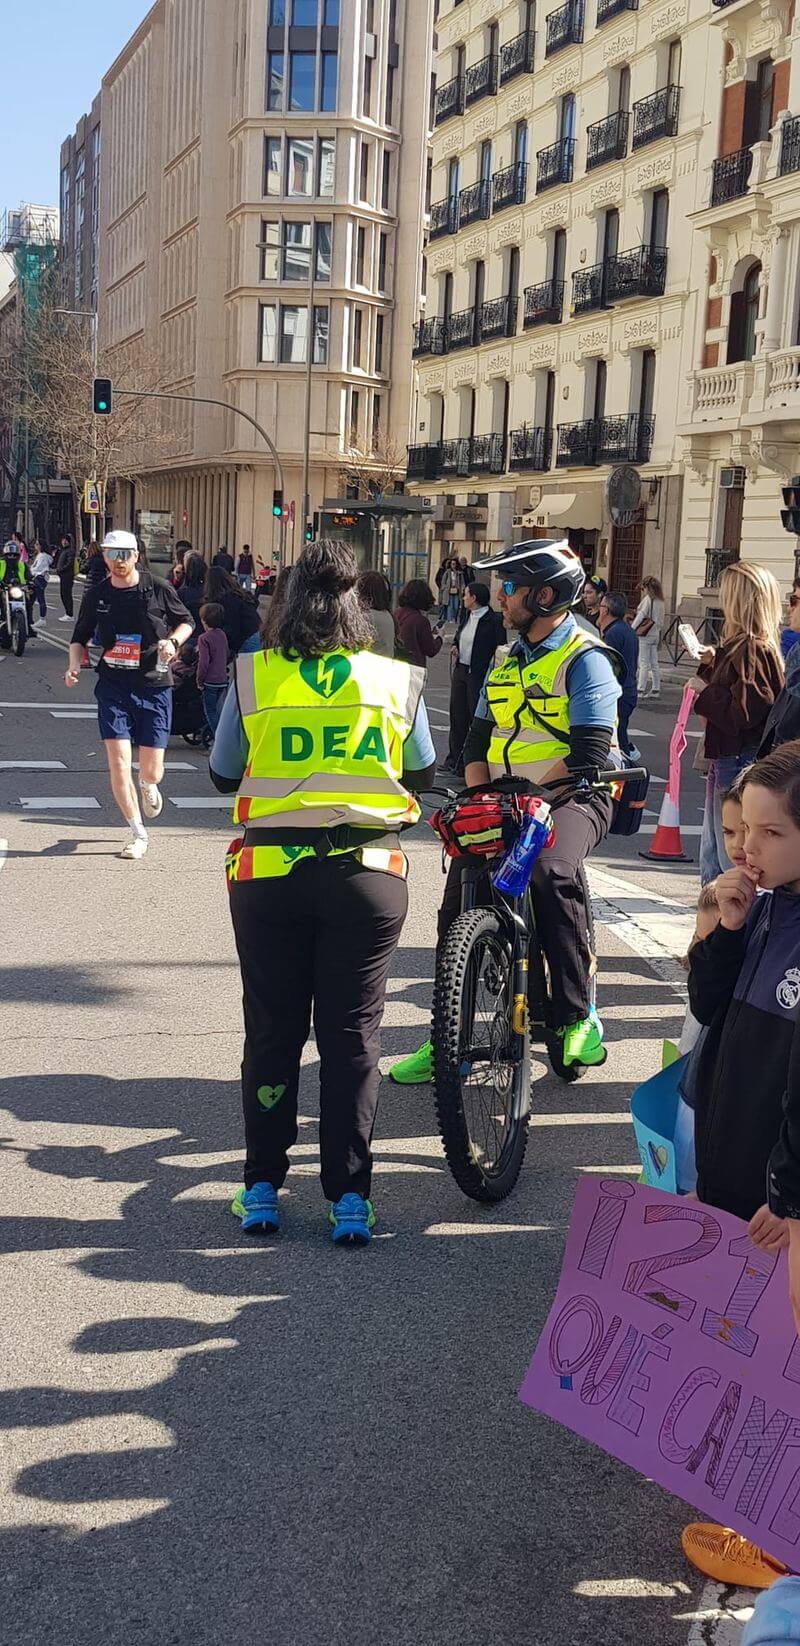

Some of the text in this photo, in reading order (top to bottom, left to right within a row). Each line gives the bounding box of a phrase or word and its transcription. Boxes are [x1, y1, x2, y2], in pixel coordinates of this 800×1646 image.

[281, 726, 387, 762] DEA
[577, 1179, 779, 1358] ¡21
[548, 1294, 671, 1437] QUÉ
